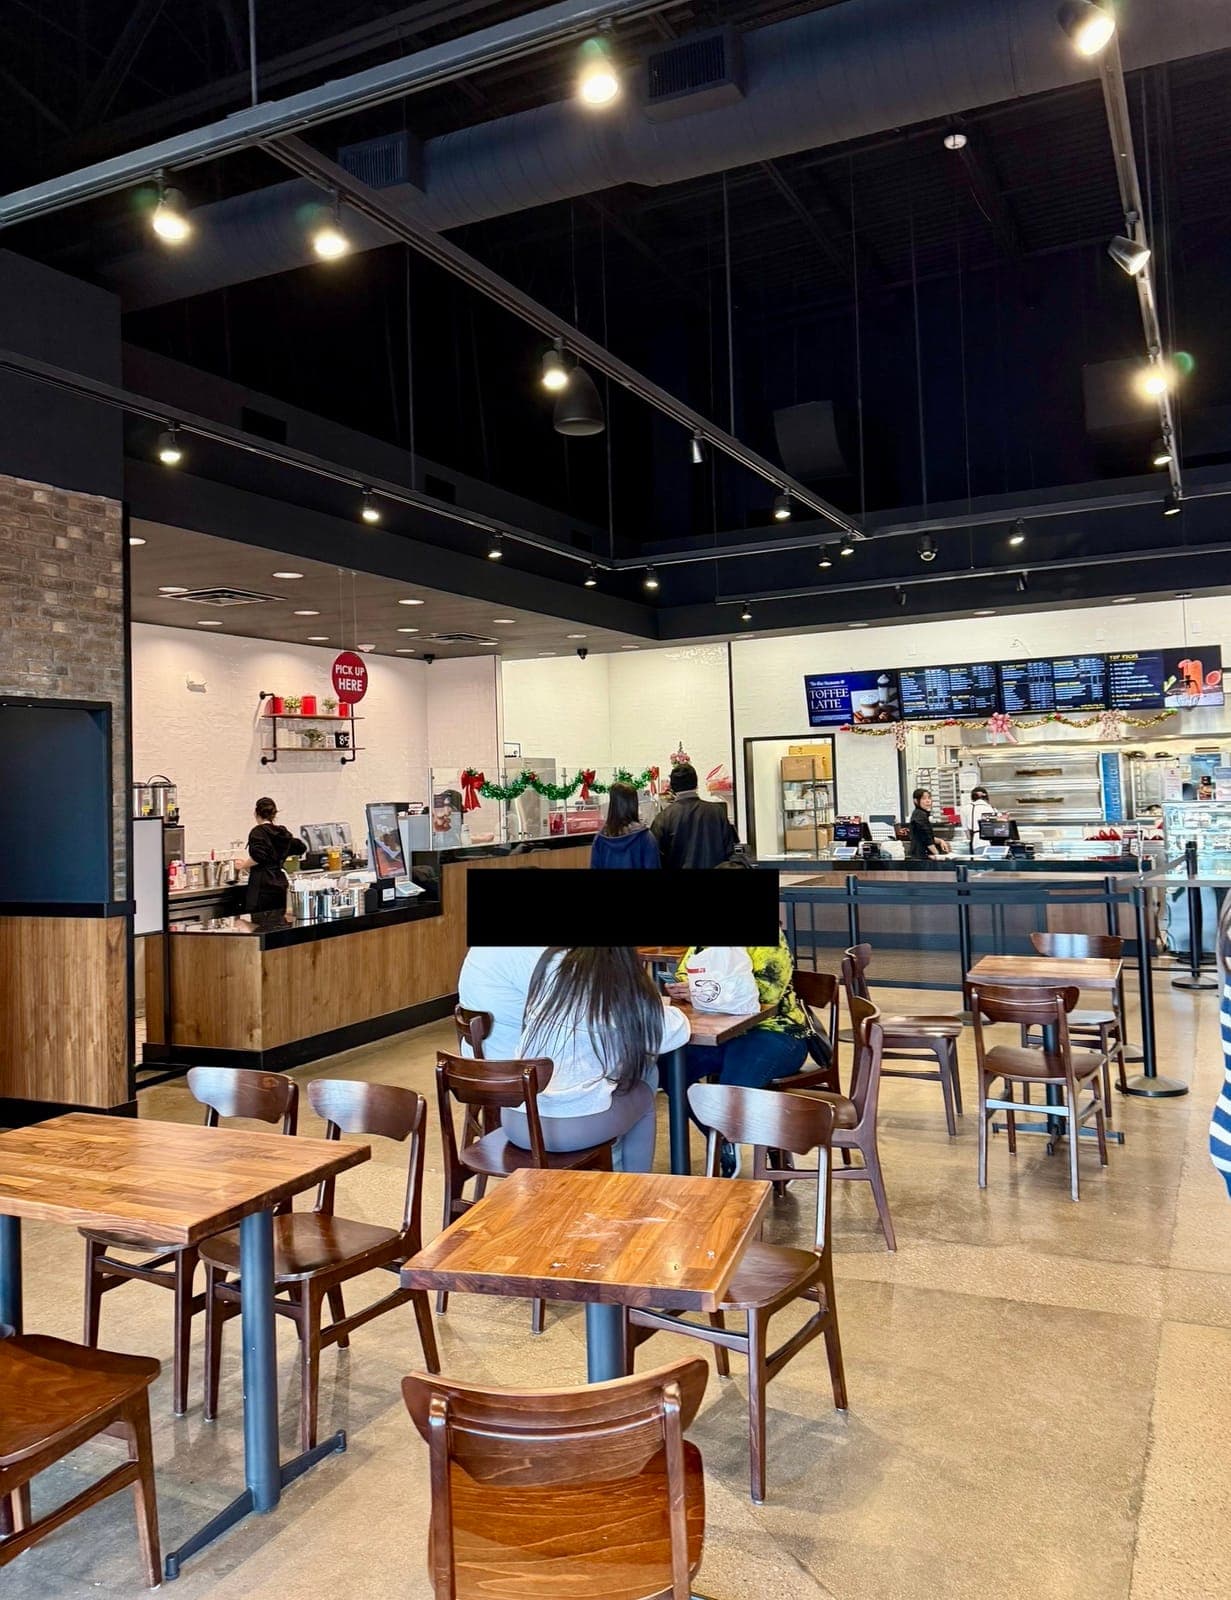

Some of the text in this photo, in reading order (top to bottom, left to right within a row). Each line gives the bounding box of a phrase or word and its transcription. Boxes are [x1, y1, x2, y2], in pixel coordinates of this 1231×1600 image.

[335, 664, 365, 676] PICK UP
[338, 678, 363, 691] HERE
[809, 688, 849, 699] TOFFEE
[810, 699, 842, 710] LATTE
